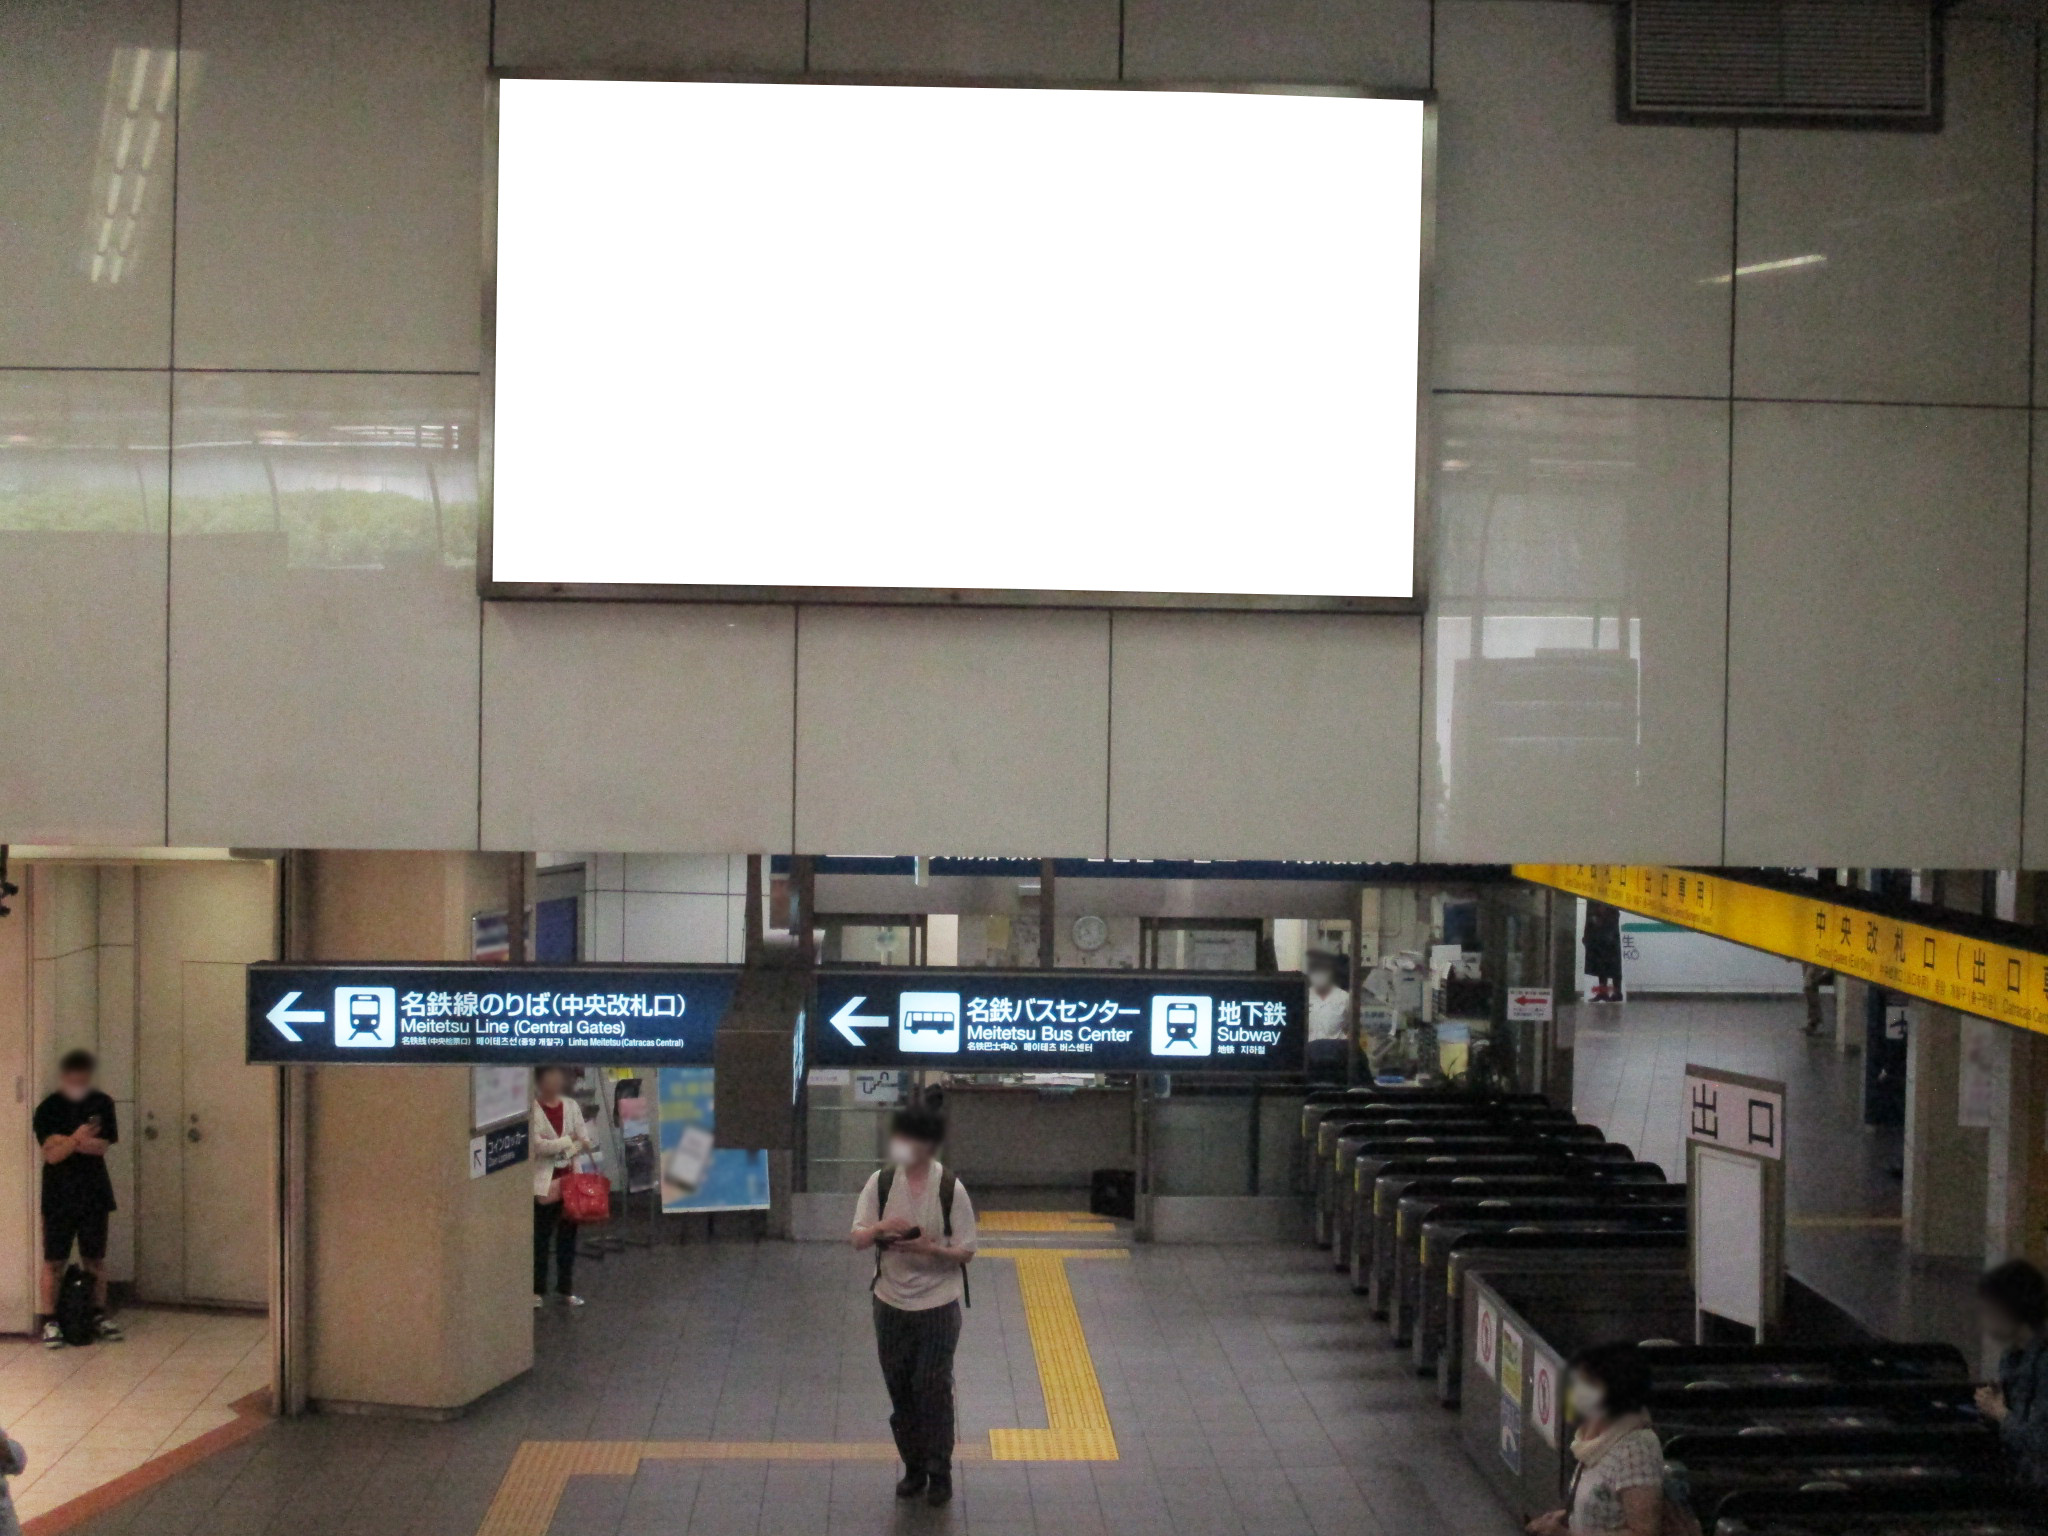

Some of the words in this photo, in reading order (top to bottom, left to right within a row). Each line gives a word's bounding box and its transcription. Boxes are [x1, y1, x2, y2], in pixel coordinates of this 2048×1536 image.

[400, 990, 686, 1018] 名鉄線のりば（中央改札口）
[966, 996, 1141, 1024] 名鉄バスセンター
[1217, 1000, 1287, 1027] 地下鉄
[400, 1018, 470, 1033] Meitetsu
[475, 1019, 509, 1034] Line
[514, 1020, 573, 1036] (Central
[576, 1020, 626, 1037] Gates)
[967, 1025, 1036, 1041] Meitetsu
[1041, 1026, 1073, 1041] Bus
[1078, 1026, 1133, 1042] Center
[1217, 1026, 1281, 1046] Subway
[568, 1038, 589, 1047] Linha
[655, 1038, 684, 1048] Central)
[1692, 1083, 1774, 1148] 出口
